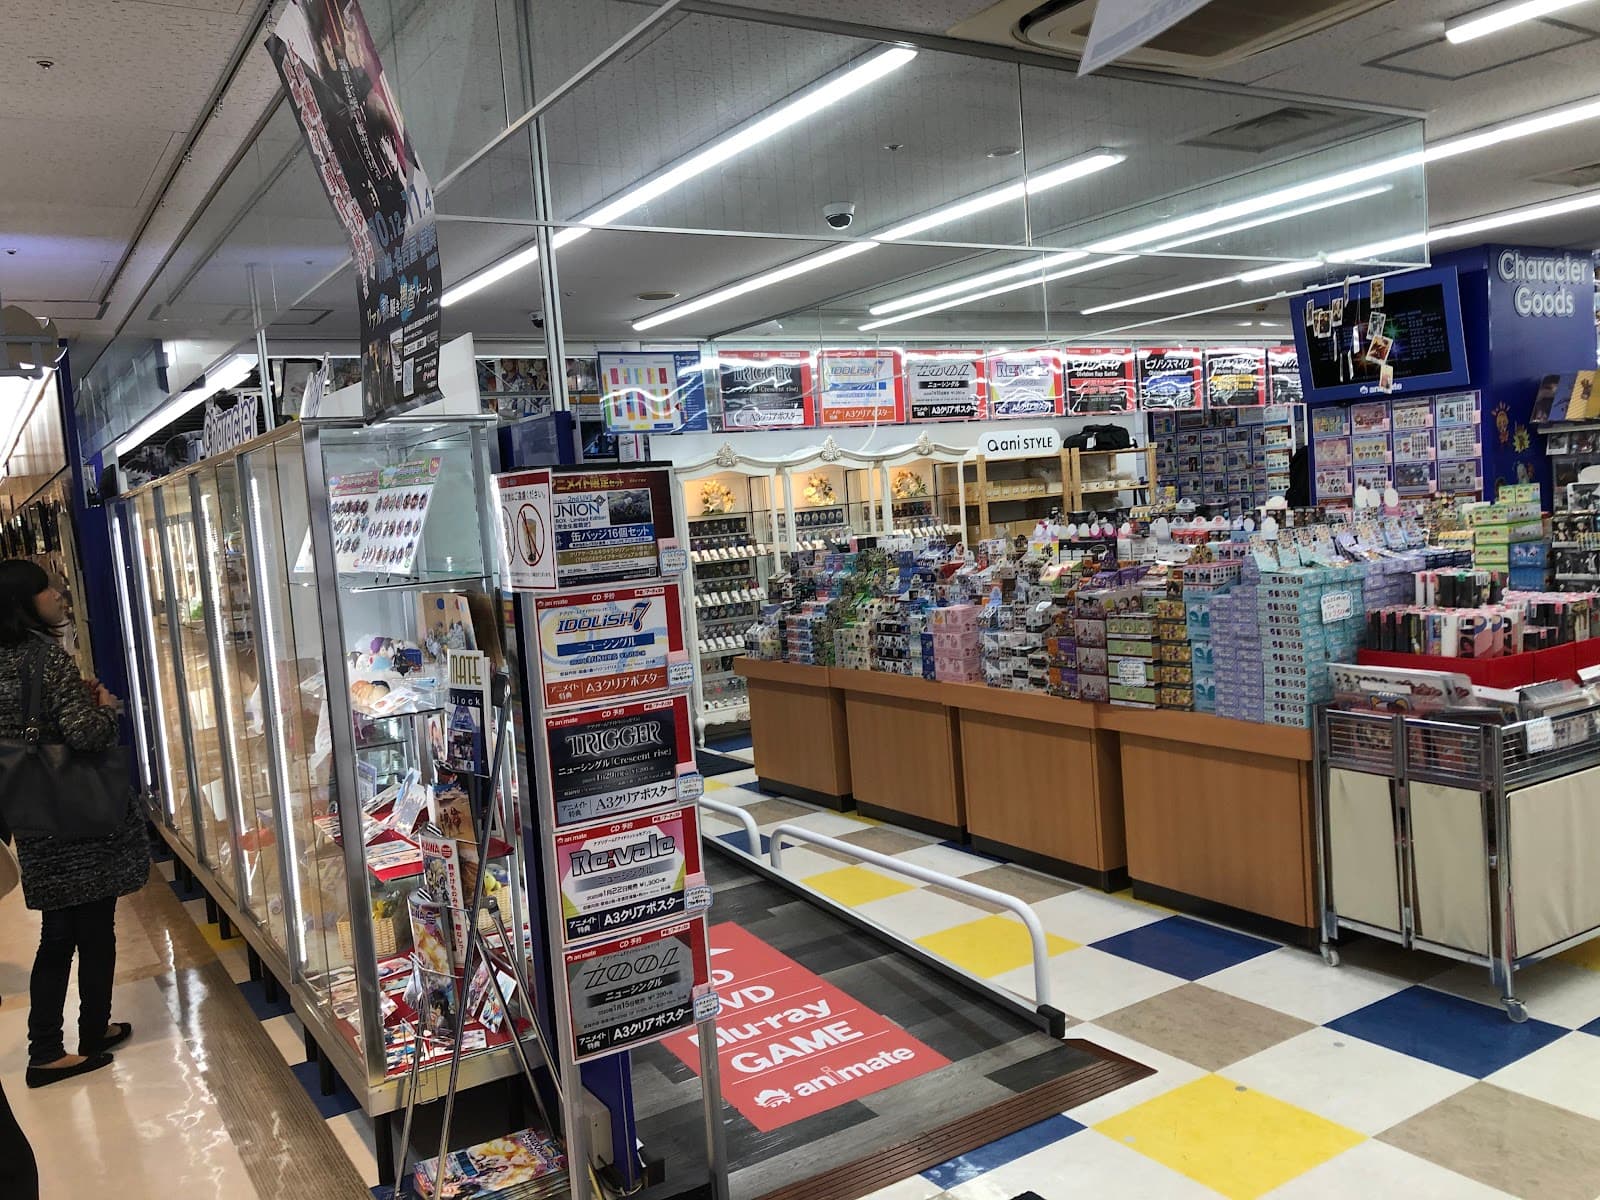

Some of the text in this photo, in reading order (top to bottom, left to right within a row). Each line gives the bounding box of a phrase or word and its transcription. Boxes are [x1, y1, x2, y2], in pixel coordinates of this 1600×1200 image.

[1499, 250, 1588, 282] Character
[1516, 285, 1575, 315] Goods
[204, 392, 258, 460] Character
[1024, 436, 1053, 449] STYLE
[570, 526, 650, 541] 缶バッジ16個セット
[585, 671, 665, 694] A3クリアポスター
[451, 696, 481, 706] block
[601, 710, 612, 718] CD
[565, 721, 664, 758] TRIGGER
[561, 802, 588, 812] アニメイト
[595, 785, 676, 811] A3クリアポスター
[610, 824, 620, 832] CD
[569, 917, 598, 929] アニメイト
[603, 896, 684, 926] A3クリアポスター
[619, 940, 630, 949] CD
[605, 977, 663, 1001] ニューシングル
[716, 985, 775, 1015] VD
[613, 1007, 694, 1041] A3クリアポスター
[579, 1032, 607, 1045] アニメイト
[731, 1020, 864, 1073] GAME
[793, 1047, 916, 1097] animate
